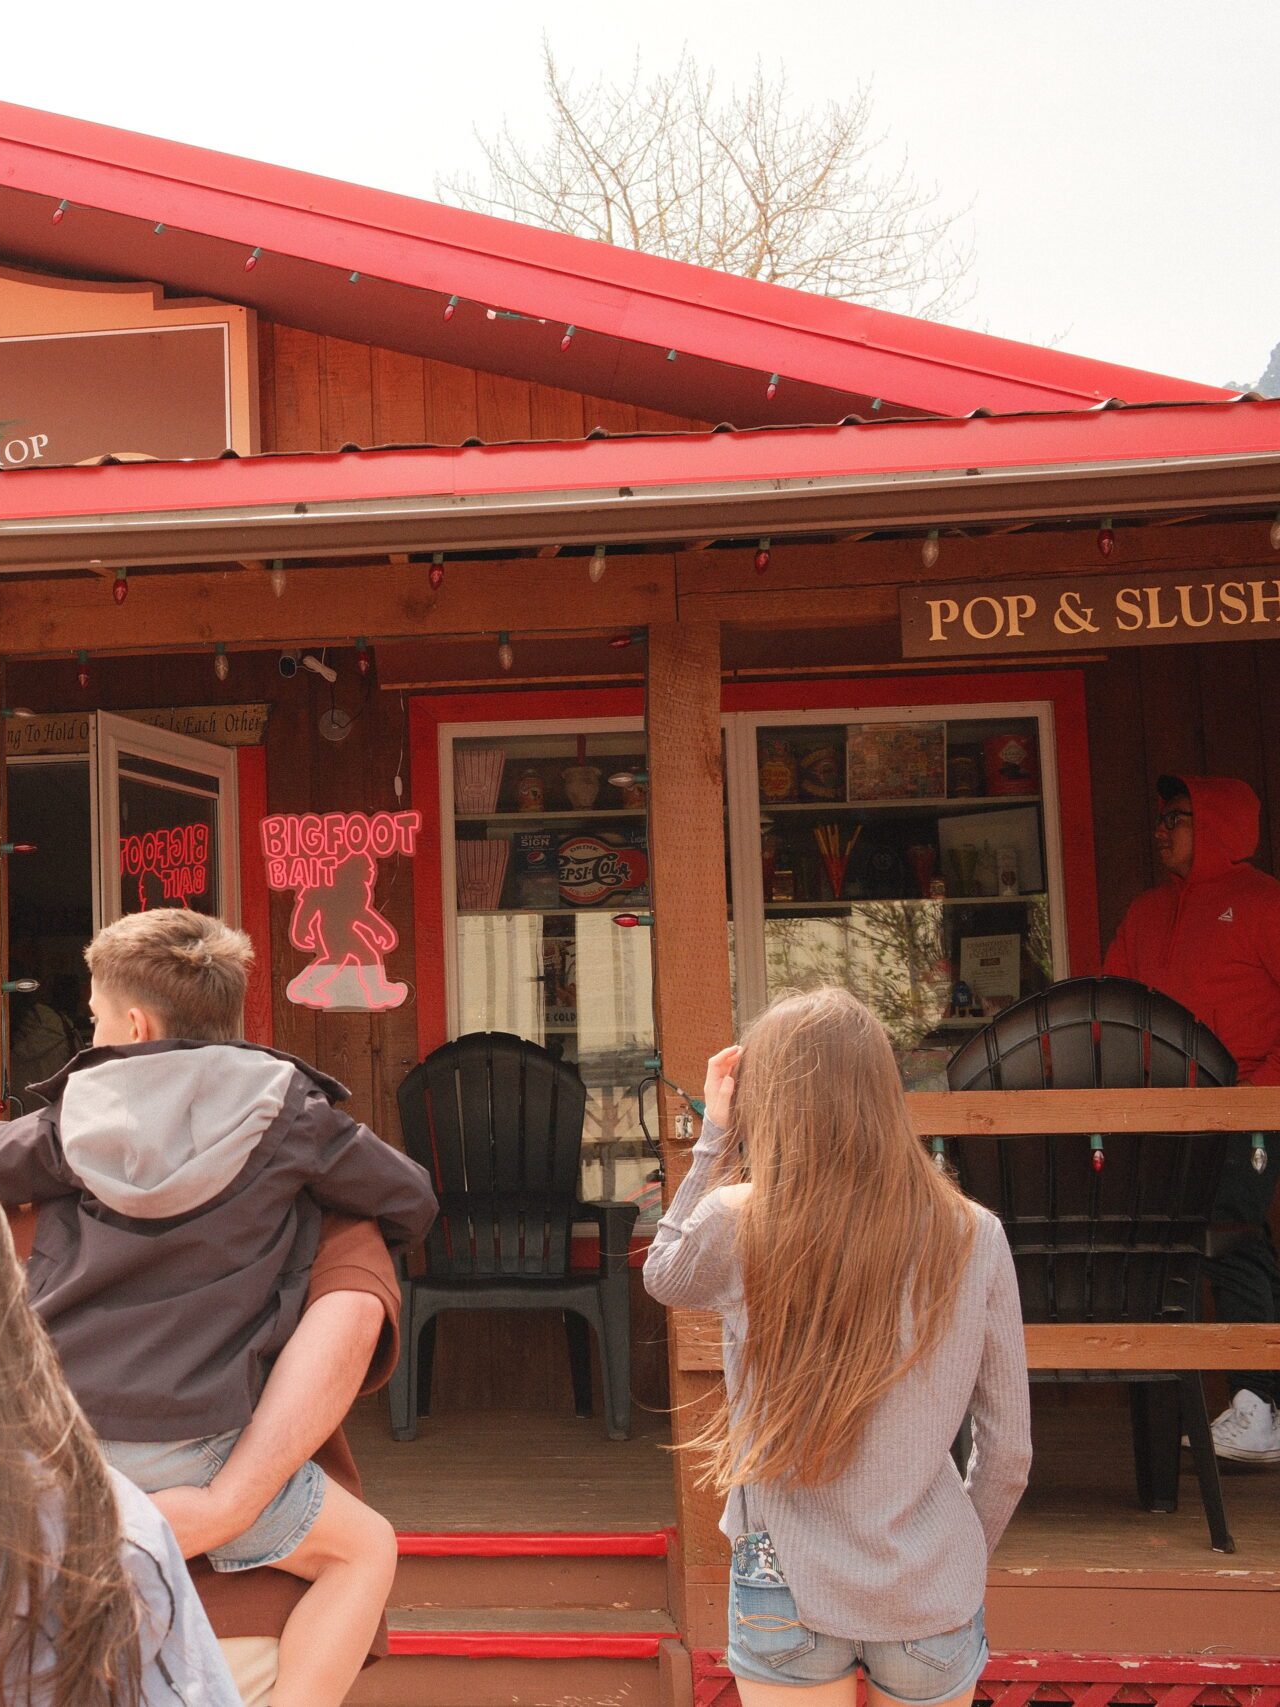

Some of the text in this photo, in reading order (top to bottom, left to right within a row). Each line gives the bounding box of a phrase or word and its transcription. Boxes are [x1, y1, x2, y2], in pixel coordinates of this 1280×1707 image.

[926, 594, 1037, 642] POP
[1053, 591, 1100, 635] &
[43, 721, 76, 742] Hold
[224, 709, 262, 733] Other
[261, 811, 421, 859] BIGFOOT
[520, 839, 550, 847] SIGN
[268, 856, 338, 888] BAIT
